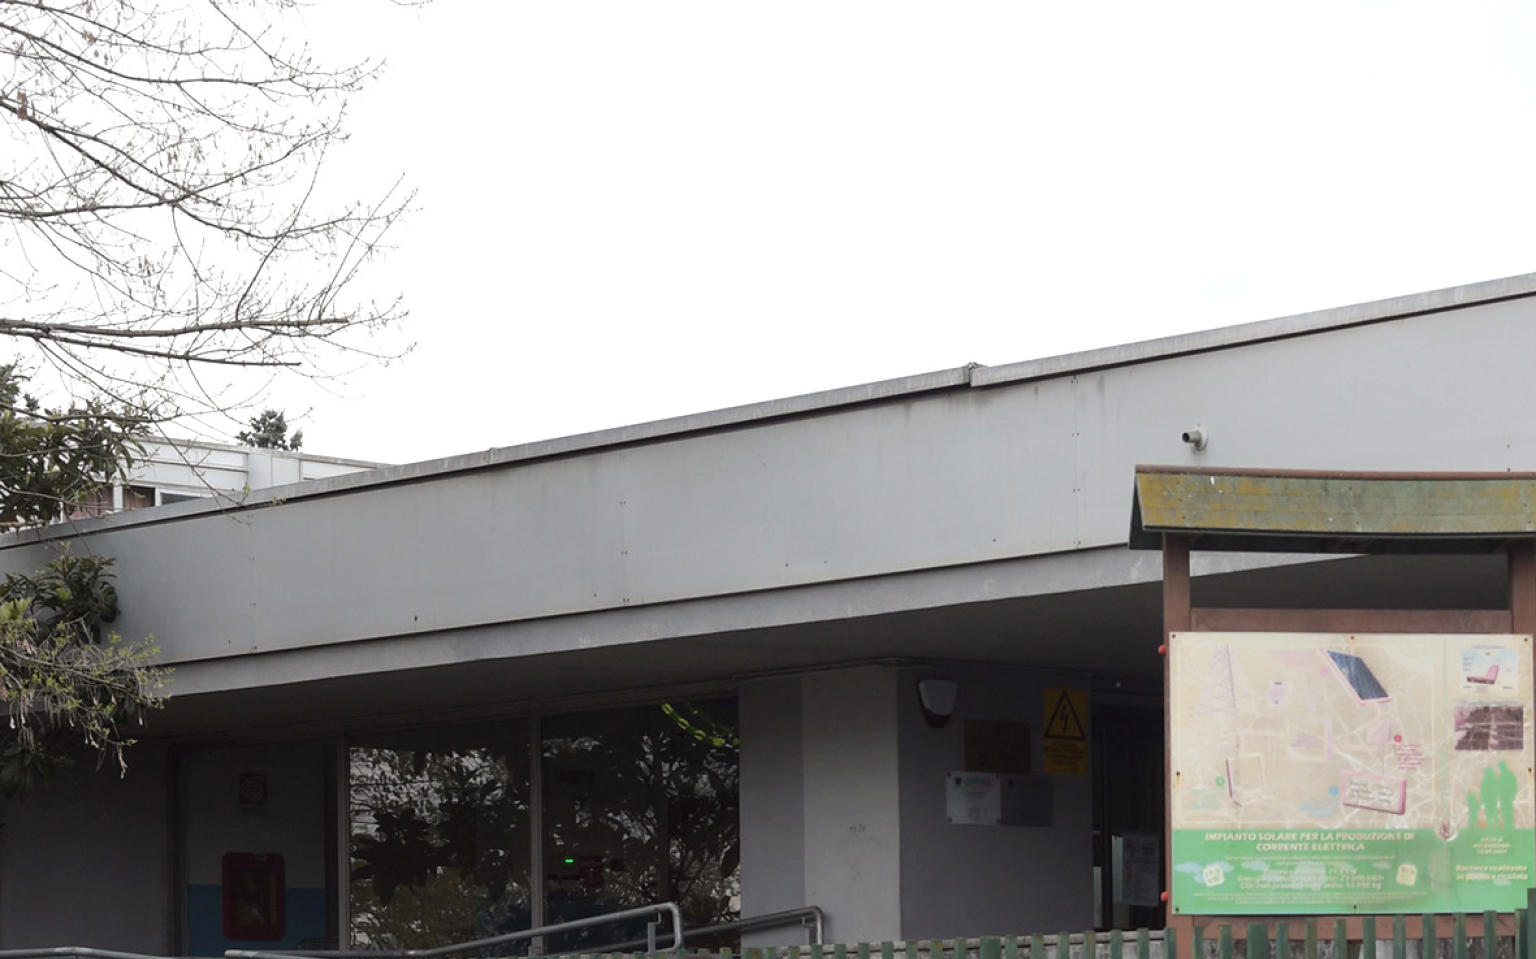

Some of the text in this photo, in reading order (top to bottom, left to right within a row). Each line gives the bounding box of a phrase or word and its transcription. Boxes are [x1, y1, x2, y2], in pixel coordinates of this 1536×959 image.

[1205, 832, 1415, 841] IMPIANTO SOLARE PER LA PRODUZIONE DI
[1256, 843, 1365, 851] CORRENTE ELETTRICA
